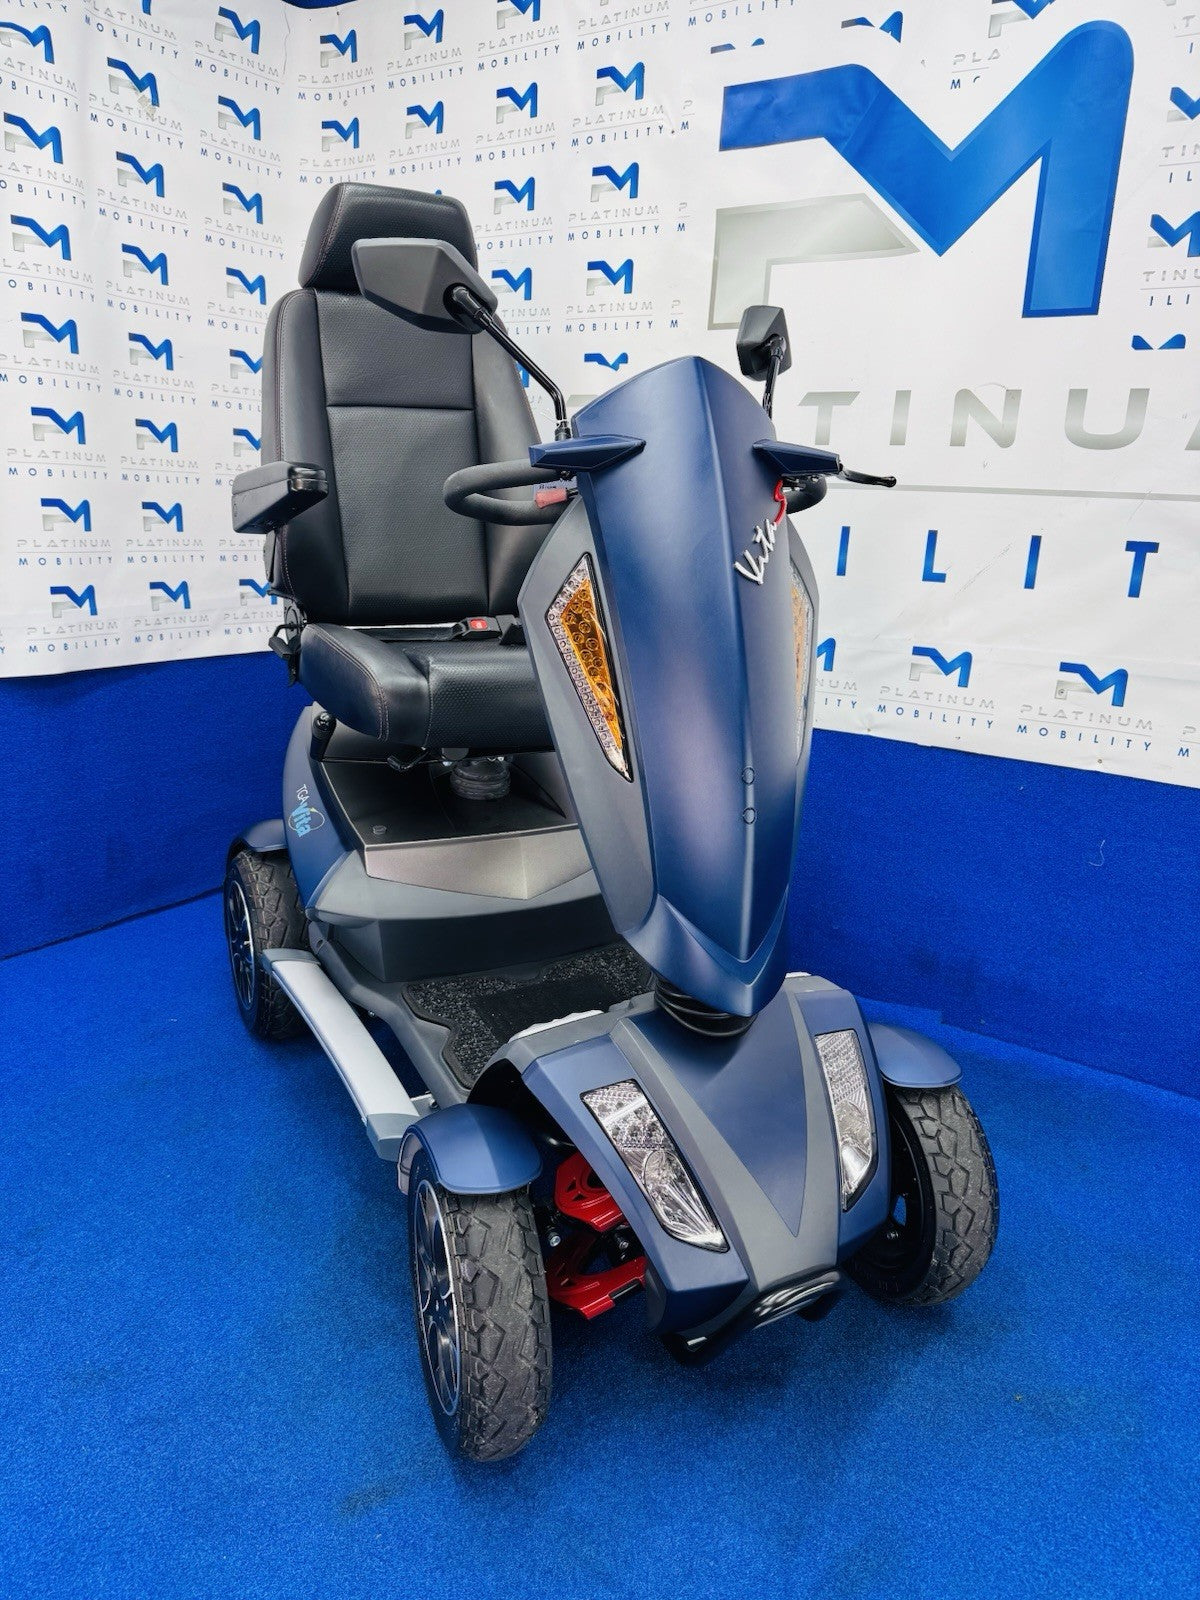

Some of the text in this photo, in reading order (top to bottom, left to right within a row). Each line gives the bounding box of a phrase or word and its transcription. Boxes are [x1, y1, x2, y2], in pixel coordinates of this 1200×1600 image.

[577, 0, 670, 30] PLATINUM
[84, 14, 179, 59] MOBILITY
[478, 25, 559, 51] PLATINUM
[577, 22, 670, 50] MOBILITY
[194, 40, 279, 77] PLATINUM
[387, 47, 462, 71] PLATINUM
[478, 45, 560, 71] MOBILITY
[4, 57, 78, 92] ATINUM
[195, 58, 280, 95] MOBILITY
[298, 67, 374, 83] PLATINUM
[388, 67, 464, 89] MOBILITY
[0, 77, 79, 112] BILITY
[298, 85, 375, 100] MOBILITY
[572, 104, 665, 128] PLATINUM
[90, 112, 184, 150] MOBILITY
[475, 122, 555, 144] PLATINUM
[571, 125, 664, 147] MOBILITY
[200, 129, 281, 162] PLATINUM
[389, 139, 460, 158] PLATINUM
[475, 141, 556, 162] MOBILITY
[200, 148, 282, 178] MOBILITY
[299, 153, 376, 167] PLATINUM
[389, 157, 461, 175] MOBILITY
[0, 162, 85, 190] ATINUM
[0, 179, 86, 209] OBILITY
[97, 188, 188, 219] PLATINUM
[100, 207, 189, 237] MOBILITY
[568, 205, 660, 222] PLATINUM
[205, 217, 283, 244] PLATINUM
[474, 217, 553, 233] PLATINUM
[567, 225, 660, 241] MOBILITY
[205, 235, 284, 260] MOBILITY
[3, 258, 94, 284] LATINUM
[8, 279, 95, 302] OBILITY
[105, 280, 190, 306] PLATINUM
[108, 299, 192, 322] MOBILITY
[207, 301, 269, 318] PLATIN
[502, 308, 550, 317] TINUM
[566, 300, 653, 315] PLATINUM
[208, 319, 259, 334] MOBIL
[565, 320, 654, 333] MOBILITY
[113, 369, 195, 389] PLATINUM
[211, 383, 262, 396] PLATI
[114, 388, 197, 405] MOBILITY
[212, 400, 261, 412] MOBIL
[797, 388, 1200, 452] TINU
[7, 448, 107, 463] PLATINUM
[120, 456, 199, 469] PLATINUM
[8, 467, 108, 480] MOBILITY
[121, 474, 200, 484] MOBILITY
[17, 539, 112, 548] PLATINUM
[126, 539, 203, 547] PLATINUM
[19, 557, 113, 566] MOBILITY
[127, 554, 205, 563] MOBILITY
[836, 526, 1160, 598] ILIT
[134, 615, 209, 627] PLATINUM
[224, 610, 282, 620] PLATINU
[27, 621, 119, 636] PLATINUM
[134, 629, 211, 643] MOBILITY
[225, 626, 270, 635] MOBIL
[29, 637, 120, 653] MOBILITY
[879, 685, 995, 709] PLATINUM
[877, 704, 994, 729] MOBILITY
[1020, 704, 1153, 730] PLATINUM
[1016, 724, 1152, 751] MOBILITY
[292, 801, 312, 838] Vita
